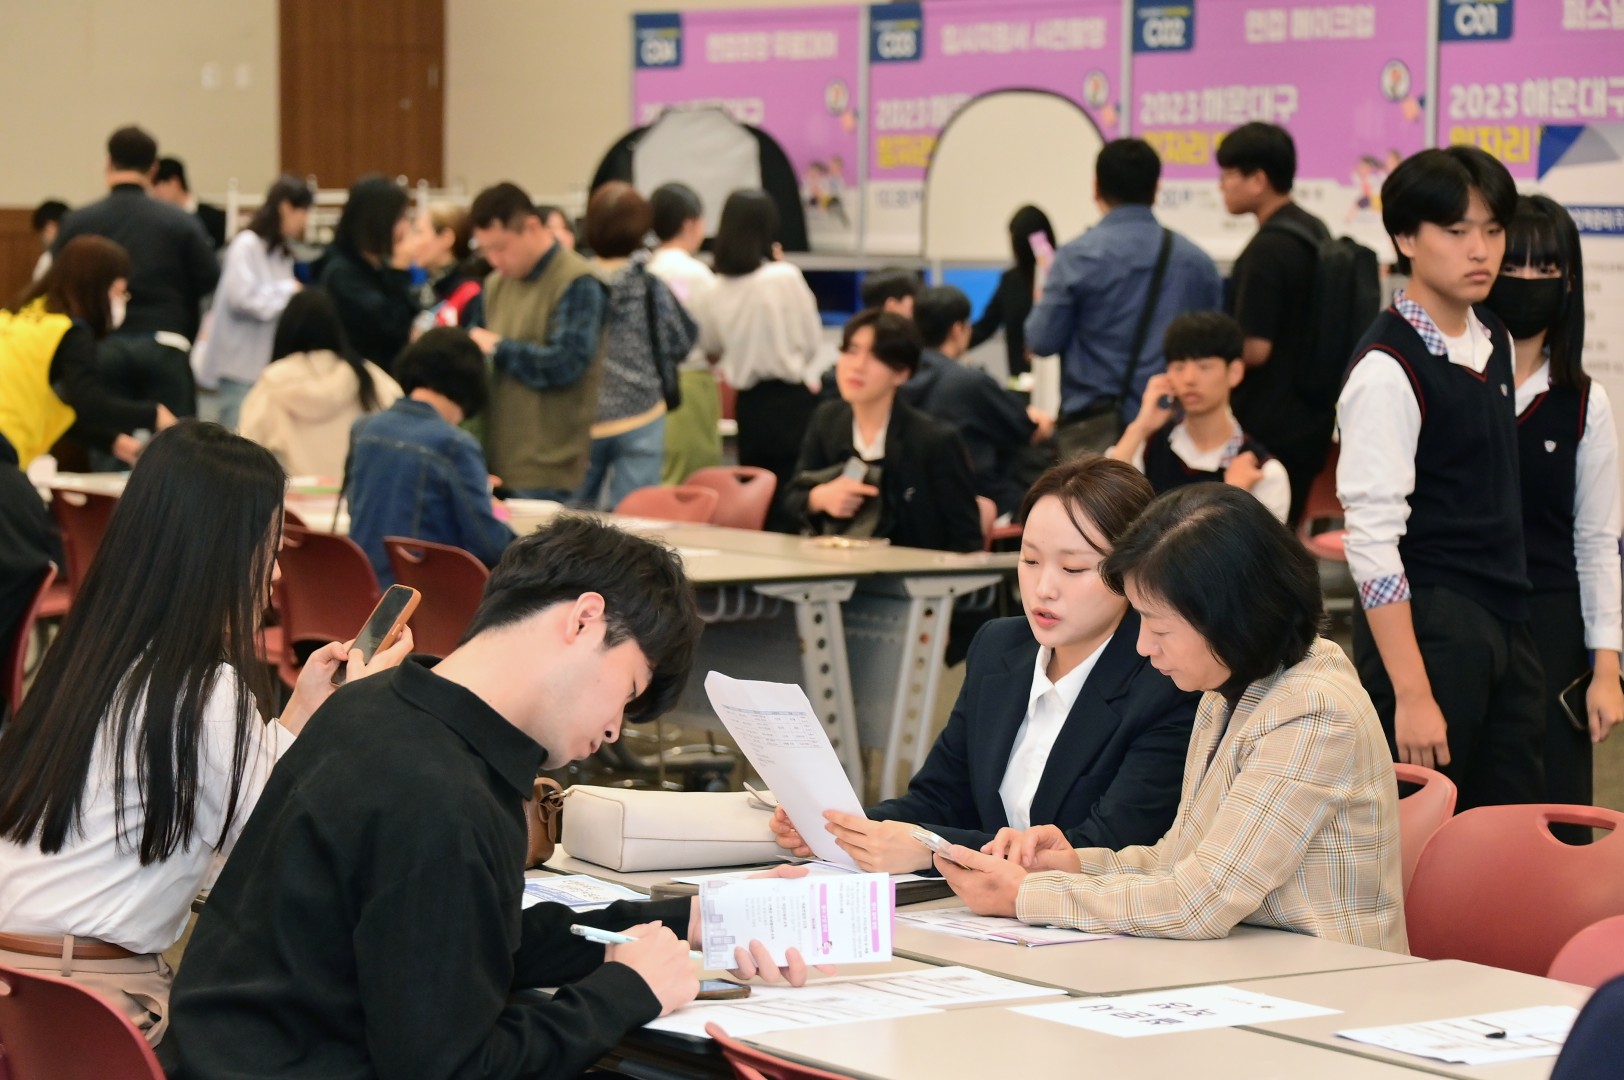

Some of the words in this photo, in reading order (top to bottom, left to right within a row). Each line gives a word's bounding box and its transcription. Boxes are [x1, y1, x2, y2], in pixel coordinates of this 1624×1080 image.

[1142, 16, 1187, 48] C02
[1454, 3, 1498, 36] C01
[1450, 82, 1519, 119] 2023
